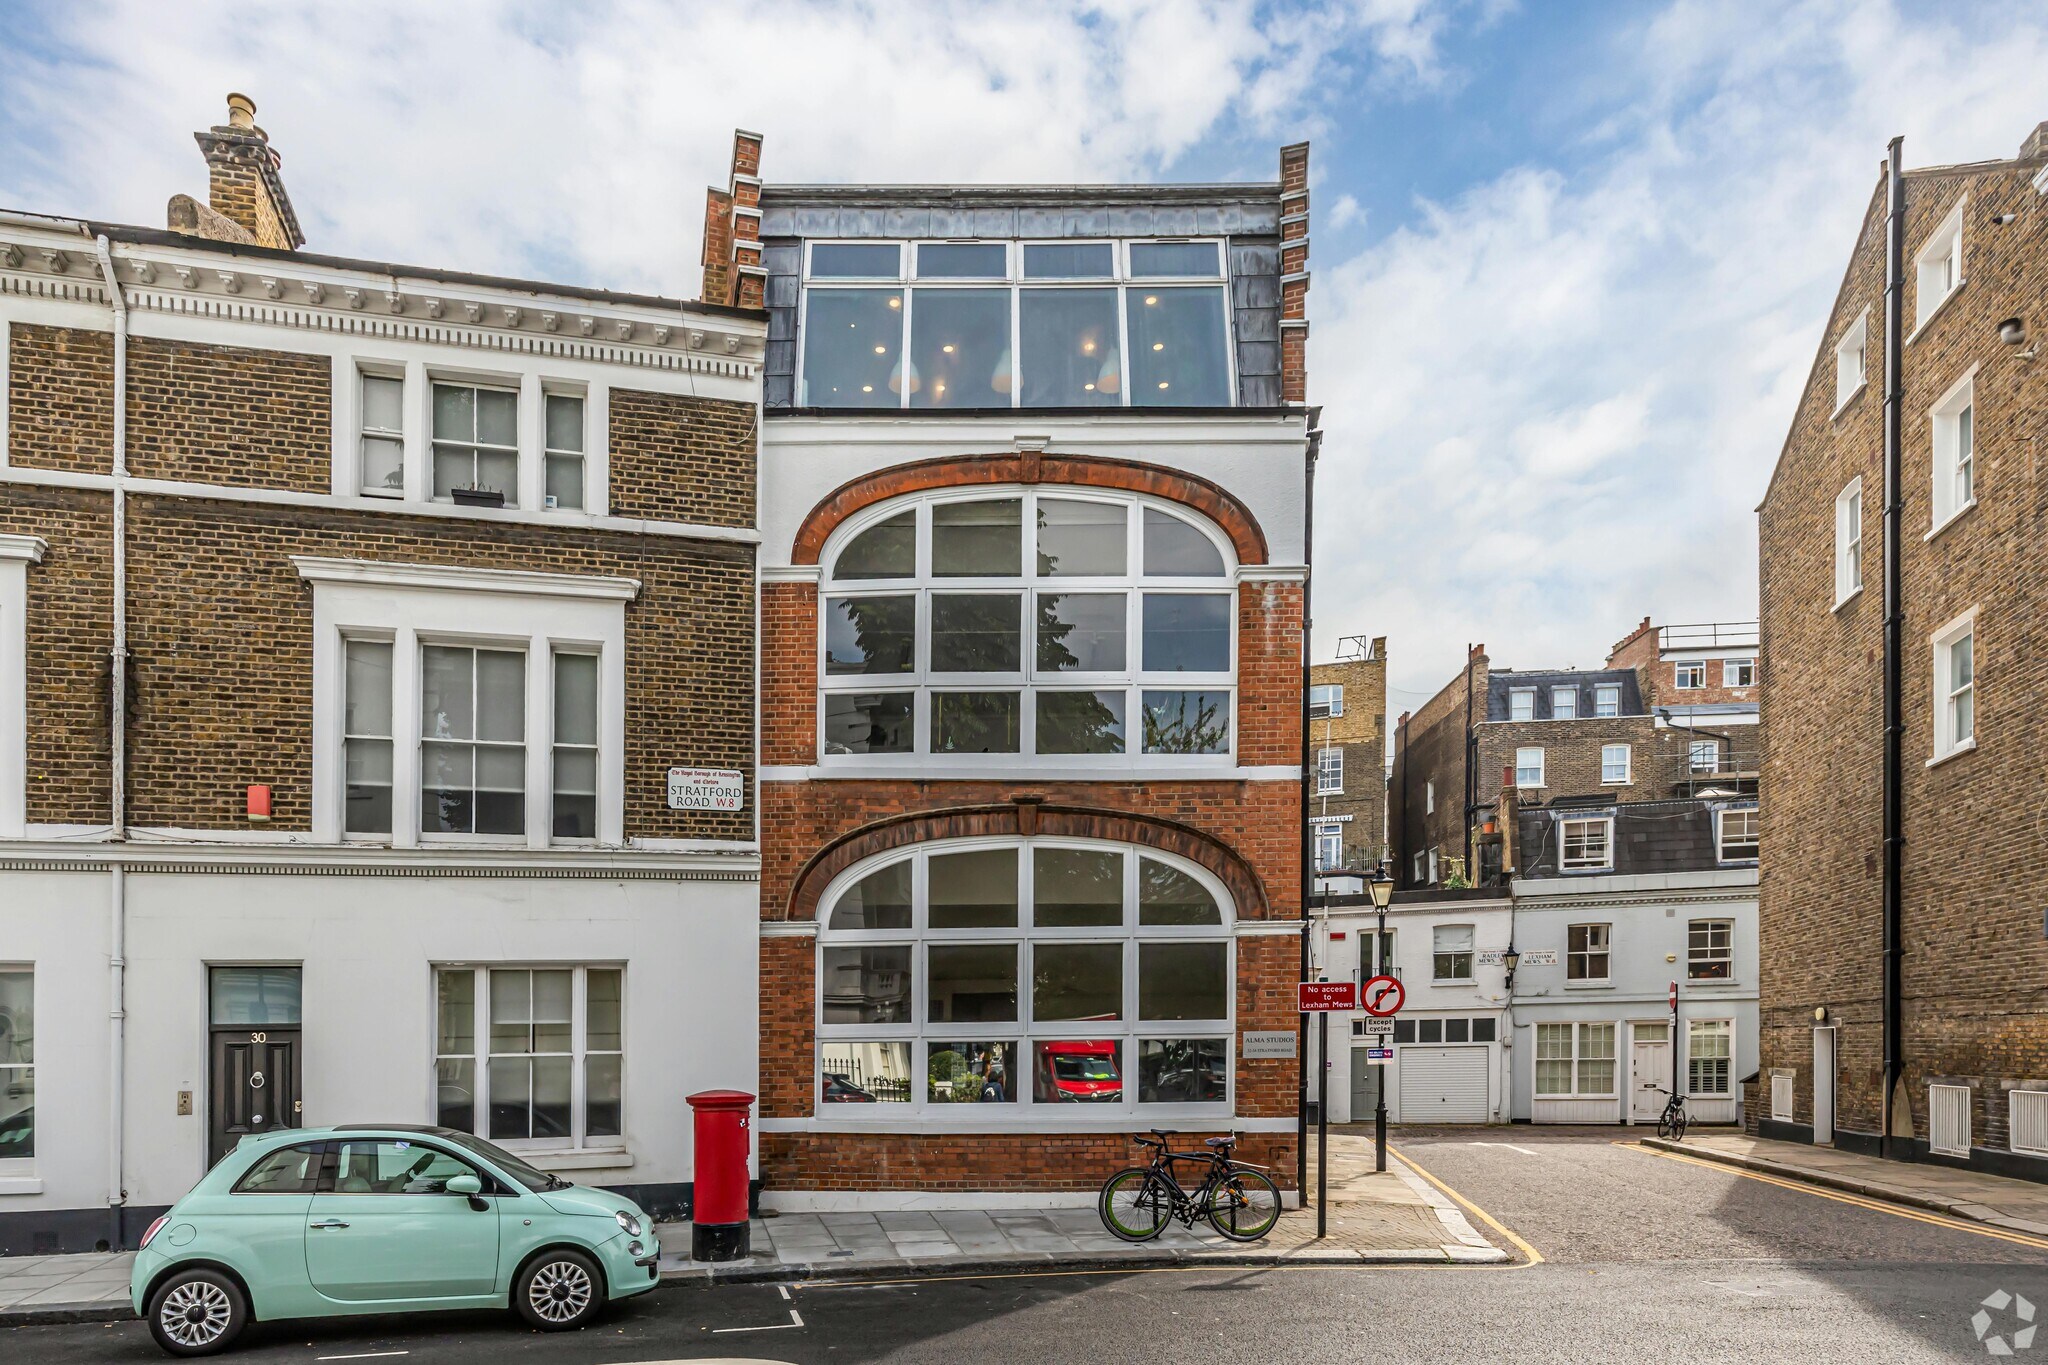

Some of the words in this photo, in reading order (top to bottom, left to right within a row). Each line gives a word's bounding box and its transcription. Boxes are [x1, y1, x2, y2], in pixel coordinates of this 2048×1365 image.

[671, 785, 742, 798] STRATFORD
[716, 798, 735, 808] W.8
[250, 1031, 267, 1044] 30
